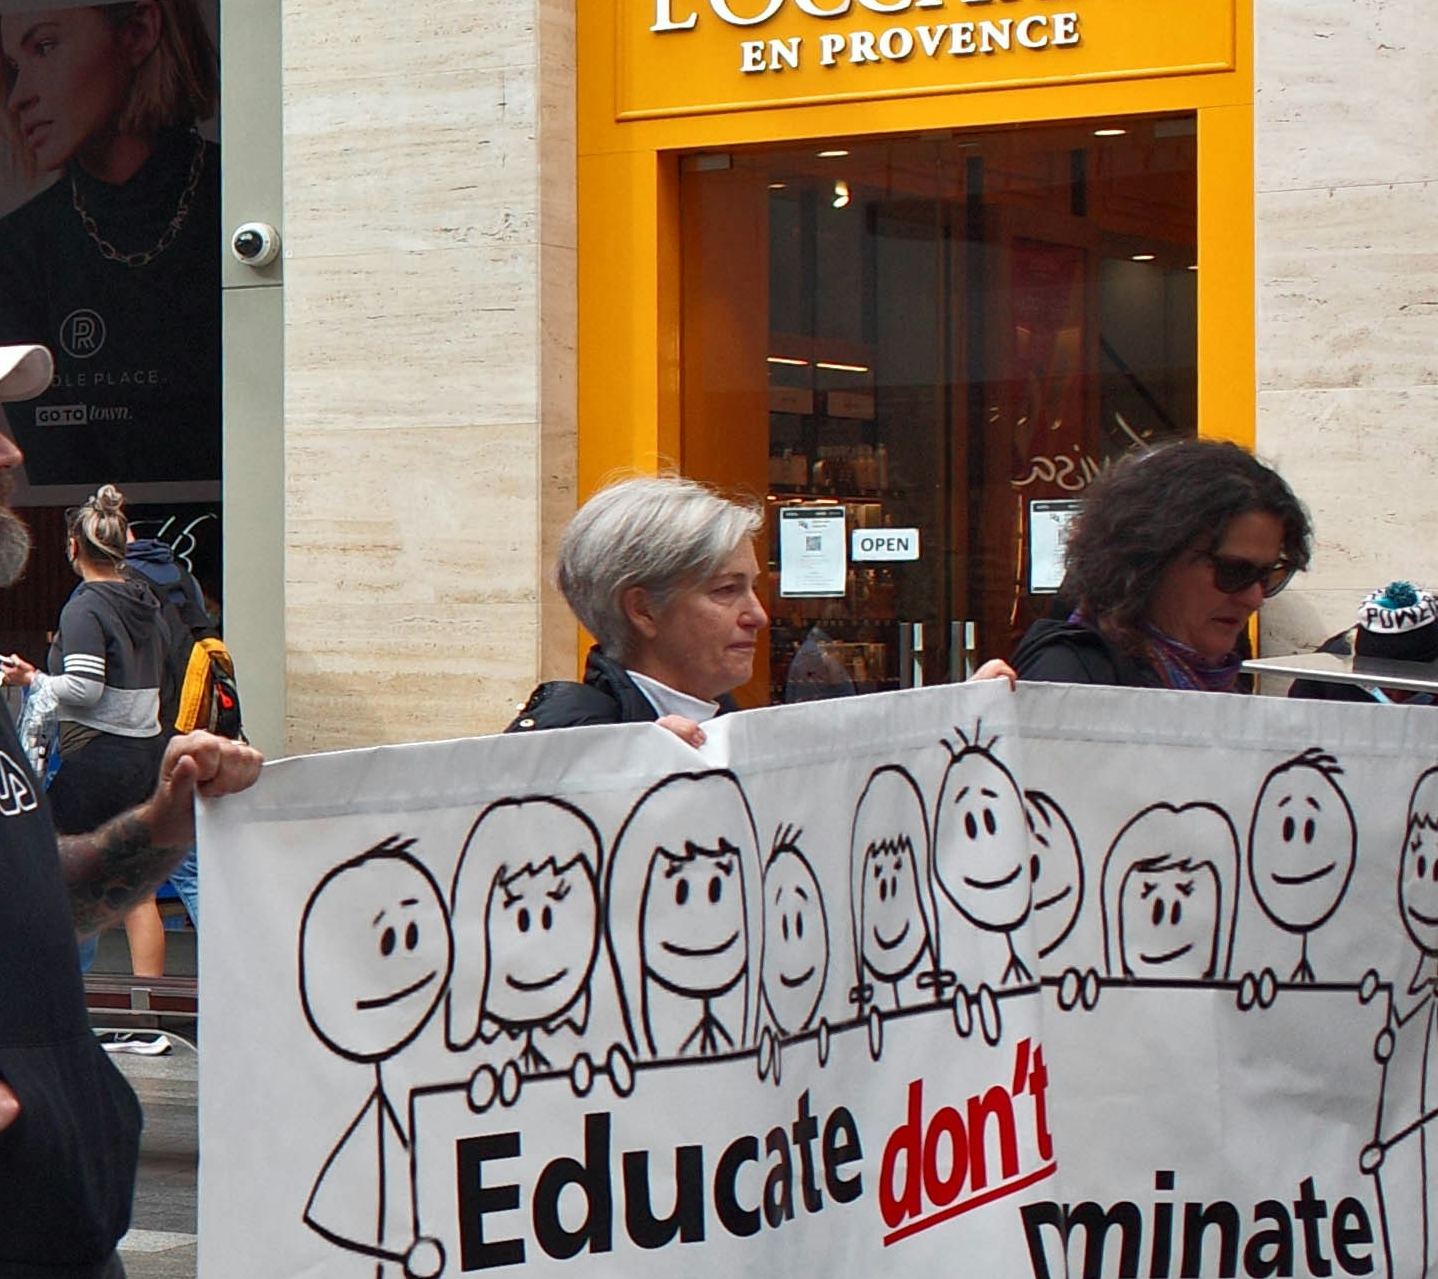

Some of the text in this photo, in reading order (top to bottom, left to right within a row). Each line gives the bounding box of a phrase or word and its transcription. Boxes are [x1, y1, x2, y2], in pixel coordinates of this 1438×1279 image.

[740, 12, 1080, 73] EN PROVENCE
[39, 410, 60, 422] GO
[62, 409, 85, 421] TO
[860, 537, 910, 552] OPEN
[455, 1036, 1054, 1272] Educate don't
